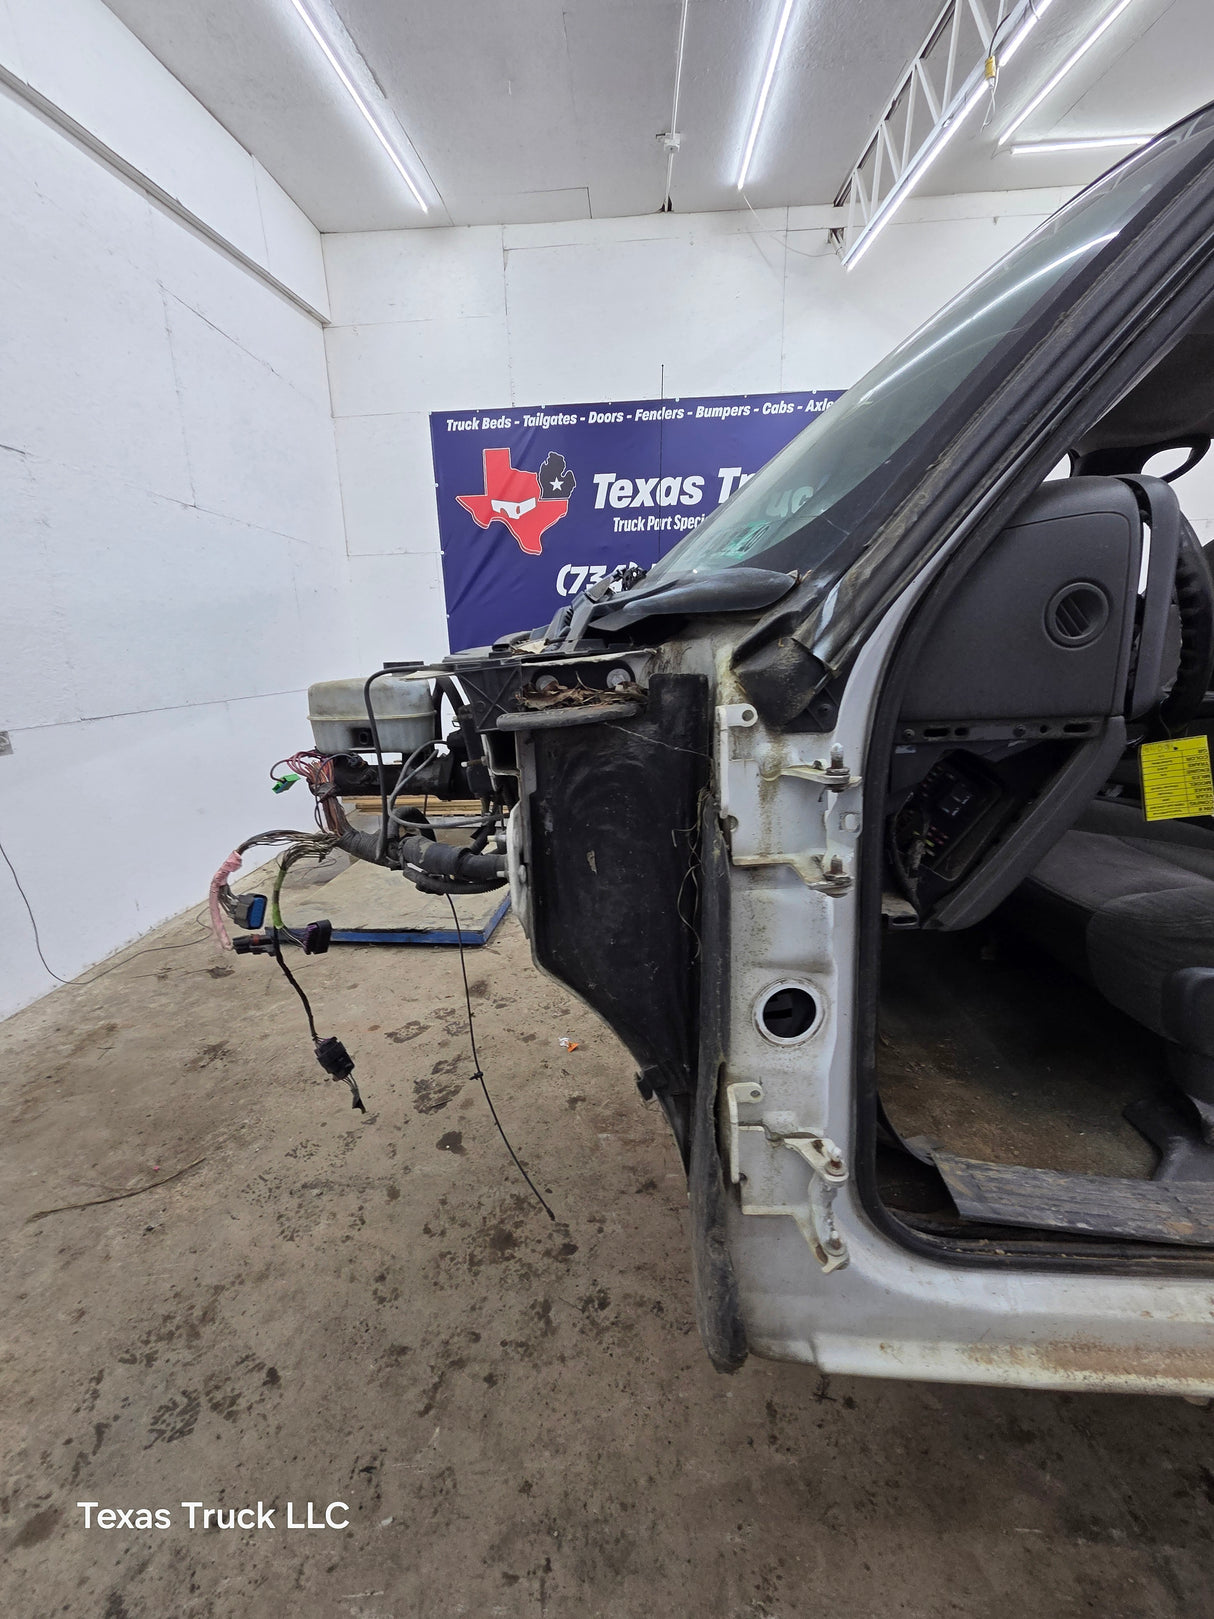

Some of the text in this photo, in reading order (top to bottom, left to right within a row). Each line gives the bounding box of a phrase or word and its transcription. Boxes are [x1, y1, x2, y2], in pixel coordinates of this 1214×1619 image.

[446, 417, 479, 432] Truck
[481, 415, 512, 430] Beds
[523, 412, 577, 429] Tailgates
[588, 411, 624, 424] Doors
[634, 406, 685, 422] Fenders
[695, 405, 751, 420] Bumpers
[762, 400, 795, 415] Cabs
[804, 398, 834, 412] Axle
[593, 473, 705, 509] Texas
[613, 513, 706, 532] Truck Part Speci
